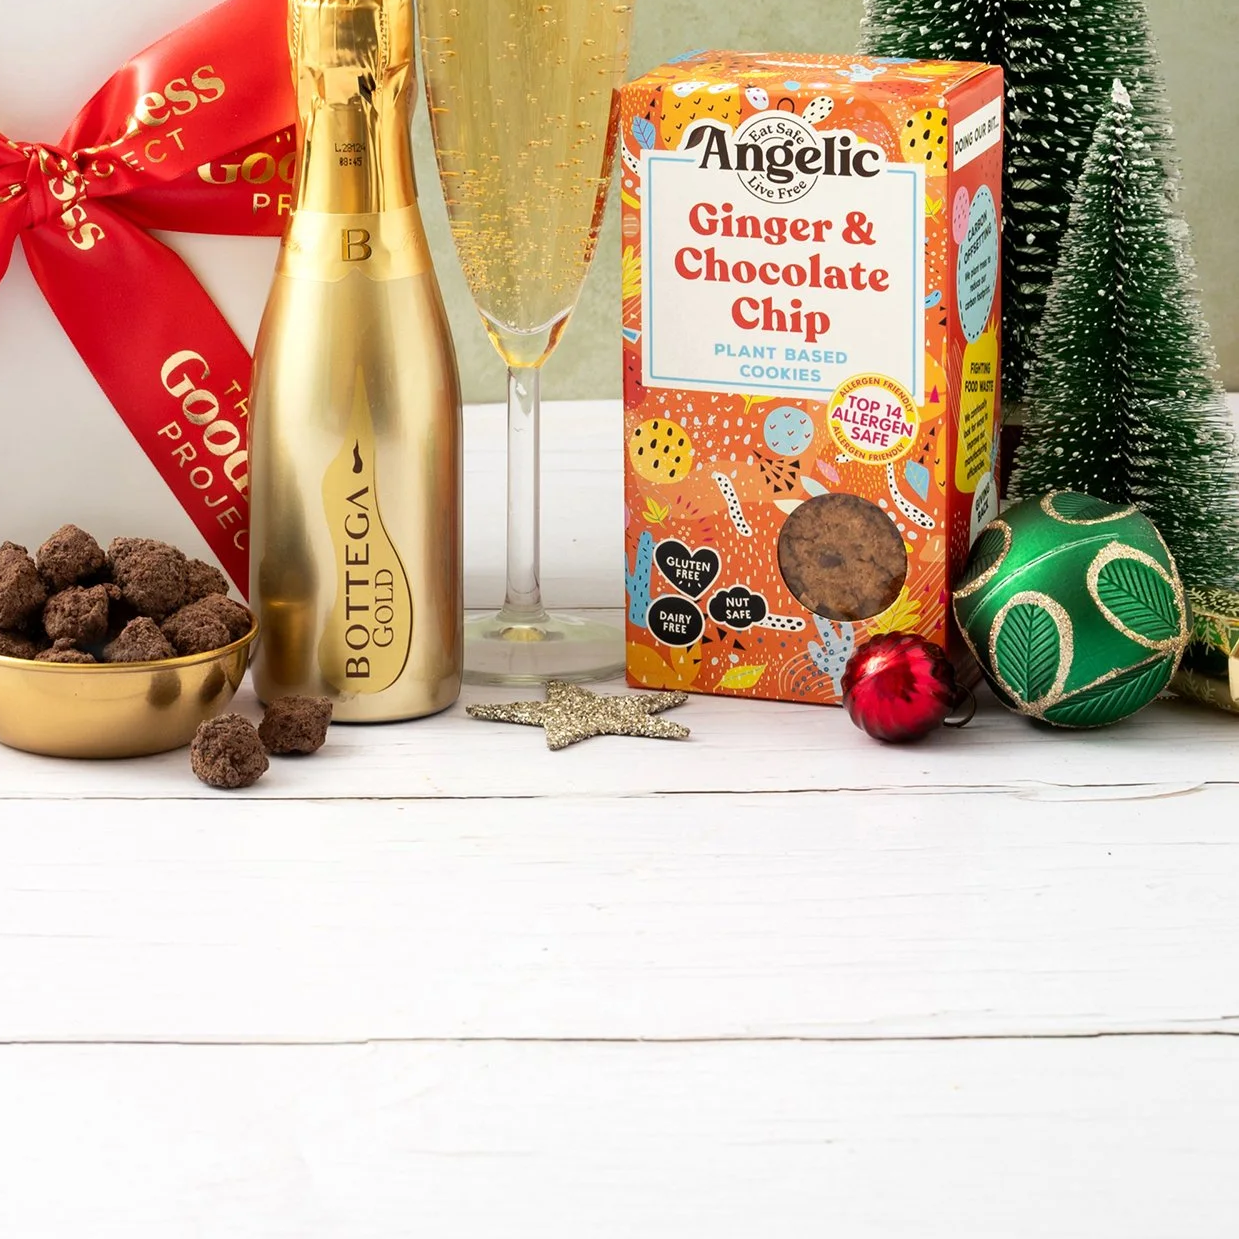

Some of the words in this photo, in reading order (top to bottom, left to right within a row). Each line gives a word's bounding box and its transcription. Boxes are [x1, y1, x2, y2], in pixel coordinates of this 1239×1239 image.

[748, 124, 773, 142] Eat
[776, 122, 805, 145] Safe
[955, 132, 973, 155] DOING
[974, 123, 987, 141] OUR
[685, 125, 880, 184] Angelic
[747, 176, 774, 198] Live
[777, 180, 807, 199] Free
[689, 202, 832, 245] Ginger
[841, 211, 876, 246] &
[341, 228, 372, 261] B
[674, 246, 890, 292] Chocolate
[731, 296, 831, 343] Chip
[714, 343, 776, 360] PLANT
[785, 347, 848, 364] BASED
[740, 364, 821, 382] COOKIES
[839, 377, 880, 398] ALLERGEN
[883, 380, 914, 413] FRIENDLY
[965, 380, 978, 392] FOOD
[979, 380, 993, 392] WASTE
[848, 395, 880, 413] TOP
[886, 404, 902, 420] 14
[832, 406, 914, 437] ALLERGEN
[832, 426, 866, 459] ALLERGEN
[868, 442, 905, 461] FRIENDLY
[850, 426, 890, 447] SAFE
[157, 421, 248, 551] PROJEC
[666, 556, 711, 573] GLUTEN
[676, 568, 700, 581] FREE
[344, 486, 370, 679] BOTTEGA
[371, 568, 394, 648] GOLD
[725, 597, 750, 607] NUT
[725, 609, 752, 619] SAFE
[659, 611, 692, 625] DAIRY
[663, 622, 687, 634] FREE
